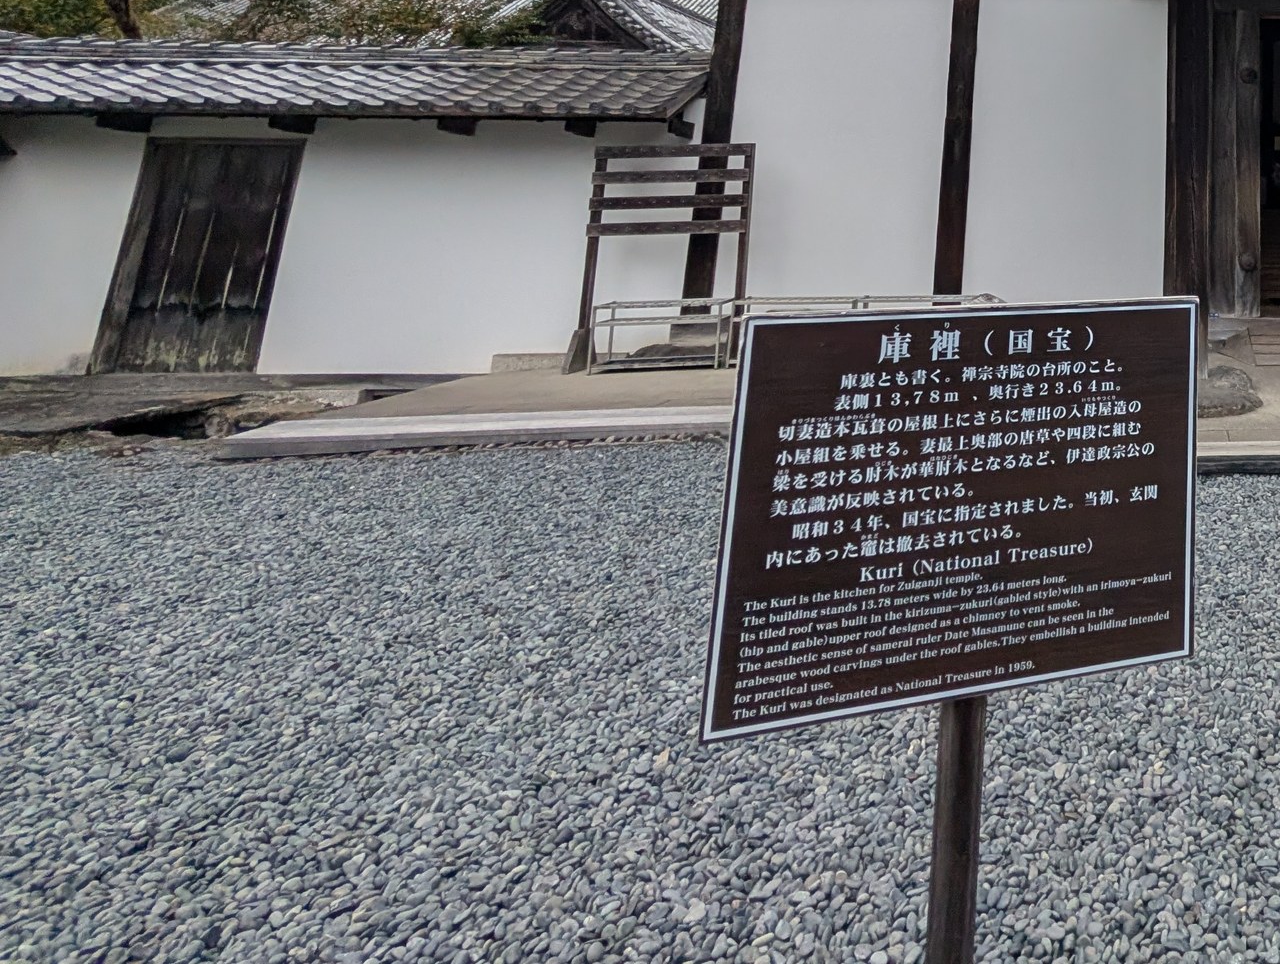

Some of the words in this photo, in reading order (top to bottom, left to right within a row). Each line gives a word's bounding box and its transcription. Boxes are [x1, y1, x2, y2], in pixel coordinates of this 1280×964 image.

[859, 561, 903, 583] Kuri
[912, 549, 1000, 576] (National
[1007, 537, 1093, 563] Treasure)
[739, 632, 756, 643] Its
[758, 625, 786, 640] tiled
[788, 621, 814, 636] roof
[815, 620, 839, 631] was
[840, 614, 868, 628] built
[870, 613, 882, 624] in
[884, 610, 903, 621] the
[1085, 583, 1099, 592] an
[741, 615, 766, 627] The
[768, 608, 818, 623] building
[819, 602, 858, 616] stands
[861, 597, 891, 611] 13.78
[893, 593, 930, 606] meters
[932, 588, 958, 600] wide
[960, 586, 974, 597] by
[976, 581, 1004, 594] 23.64
[1006, 578, 1041, 590] meters
[1042, 574, 1067, 585] long.
[743, 600, 768, 612] The
[769, 595, 797, 609] Kuri
[798, 594, 809, 605] is
[811, 591, 831, 603] the
[833, 586, 876, 600] kitchen
[878, 583, 896, 594] for
[897, 575, 943, 591] Zuiganji
[944, 571, 983, 585] temple.
[734, 671, 797, 689] arabesque
[799, 663, 831, 678] wood
[832, 658, 883, 673] carvings
[885, 651, 918, 665] under
[919, 648, 938, 659] the
[939, 642, 963, 656] roof
[1029, 625, 1077, 641] embellish
[1078, 625, 1085, 634] a
[1087, 618, 1128, 632] building
[1128, 610, 1170, 626] intended
[736, 661, 761, 673] The
[763, 652, 819, 669] aesthetic
[820, 648, 853, 660] sense
[855, 643, 868, 654] of
[869, 636, 913, 653] samerai
[915, 633, 942, 646] ruler
[943, 630, 969, 641] Date
[971, 621, 1025, 636] Masamune
[1026, 618, 1046, 628] can
[1047, 614, 1060, 625] be
[1061, 612, 1084, 623] seen
[1086, 609, 1096, 619] in
[1098, 606, 1114, 617] the
[739, 645, 764, 658] (hip
[765, 640, 789, 654] and
[863, 625, 887, 639] roof
[888, 618, 938, 635] designed
[939, 619, 951, 628] as
[953, 617, 960, 625] a
[962, 610, 1007, 624] chimney
[1009, 608, 1020, 617] to
[1021, 603, 1045, 615] vent
[1046, 598, 1081, 611] smoke.
[731, 707, 757, 720] The
[759, 701, 787, 716] Kuri
[789, 699, 813, 710] was
[814, 685, 878, 706] designated
[879, 685, 893, 695] as
[895, 674, 942, 692] National
[944, 668, 992, 684] Treasure
[994, 665, 1005, 675] in
[1008, 659, 1035, 673] 1959.
[733, 693, 752, 705] for
[753, 682, 808, 703] practical
[810, 681, 834, 692] use.
